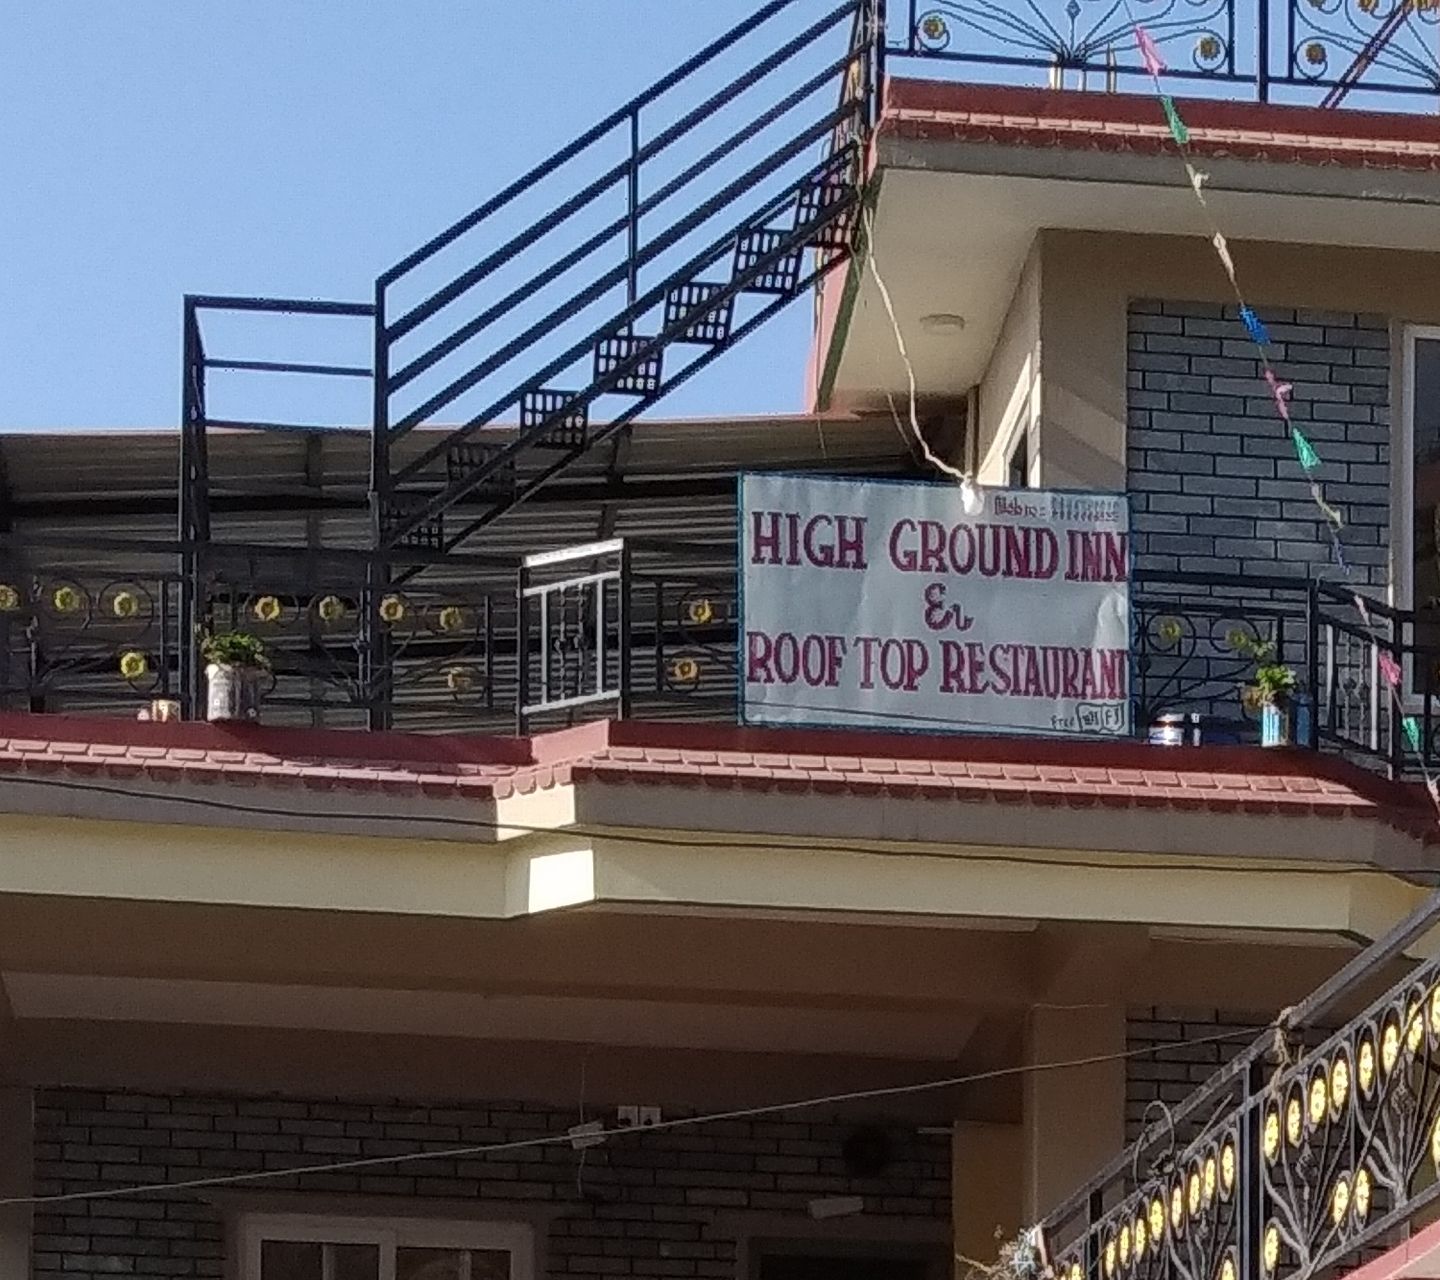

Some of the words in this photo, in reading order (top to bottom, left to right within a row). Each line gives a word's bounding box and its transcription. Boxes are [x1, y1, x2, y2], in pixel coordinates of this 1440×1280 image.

[751, 511, 868, 570] HIGH
[888, 518, 1060, 580] GROUND
[1065, 530, 1128, 582] INN
[924, 582, 975, 631] &
[747, 631, 847, 687] ROOF
[853, 636, 929, 692] TOP
[939, 640, 1128, 700] RESTAURANT
